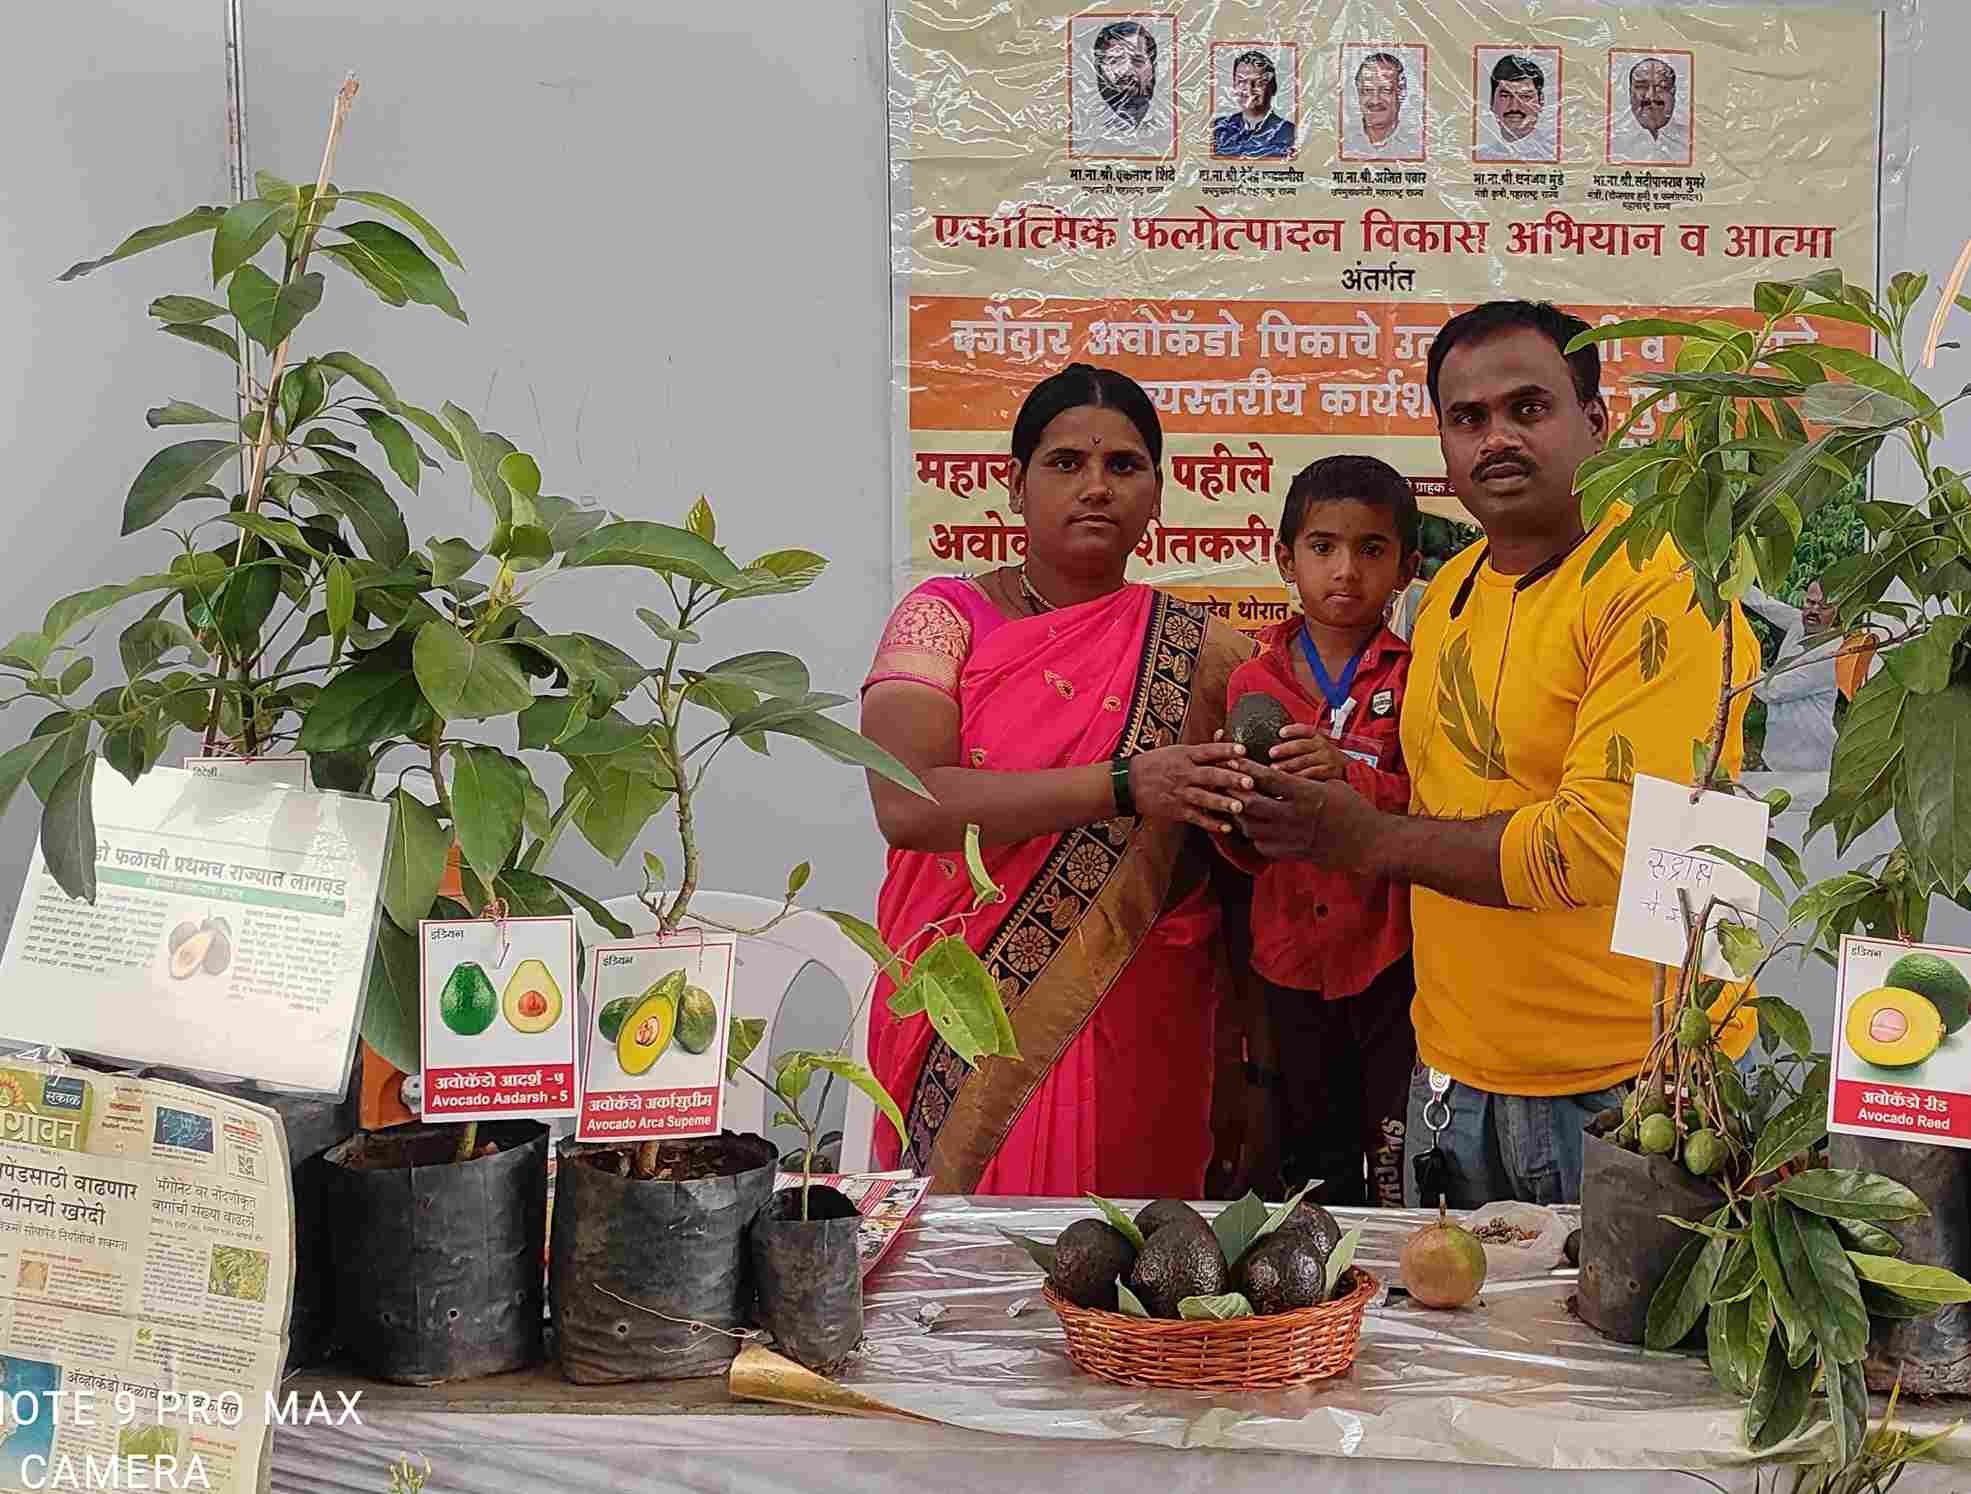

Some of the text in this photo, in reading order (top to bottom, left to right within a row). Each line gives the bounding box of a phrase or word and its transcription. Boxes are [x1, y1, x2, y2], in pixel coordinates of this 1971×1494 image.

[932, 203, 1837, 260] एकात्मिक फलोत्पादन विकास अभियान व आत्मा
[1341, 260, 1416, 292] अंतर्गत
[1088, 307, 1244, 357] अवोकॅडो
[1256, 308, 1380, 358] पिकाचे
[1319, 368, 1434, 419] कार्यशा
[1171, 441, 1274, 501] पहीले
[1238, 594, 1290, 620] थोरात
[432, 1093, 491, 1108] Avocado
[493, 1091, 549, 1106] Aadarsh
[1857, 1106, 1915, 1127] Avocado
[586, 1116, 637, 1132] Avocado
[638, 1115, 665, 1129] Arca
[0, 1156, 138, 1200] पेंडसाठी वाढणार
[0, 1188, 106, 1226] बीनची खरेदी
